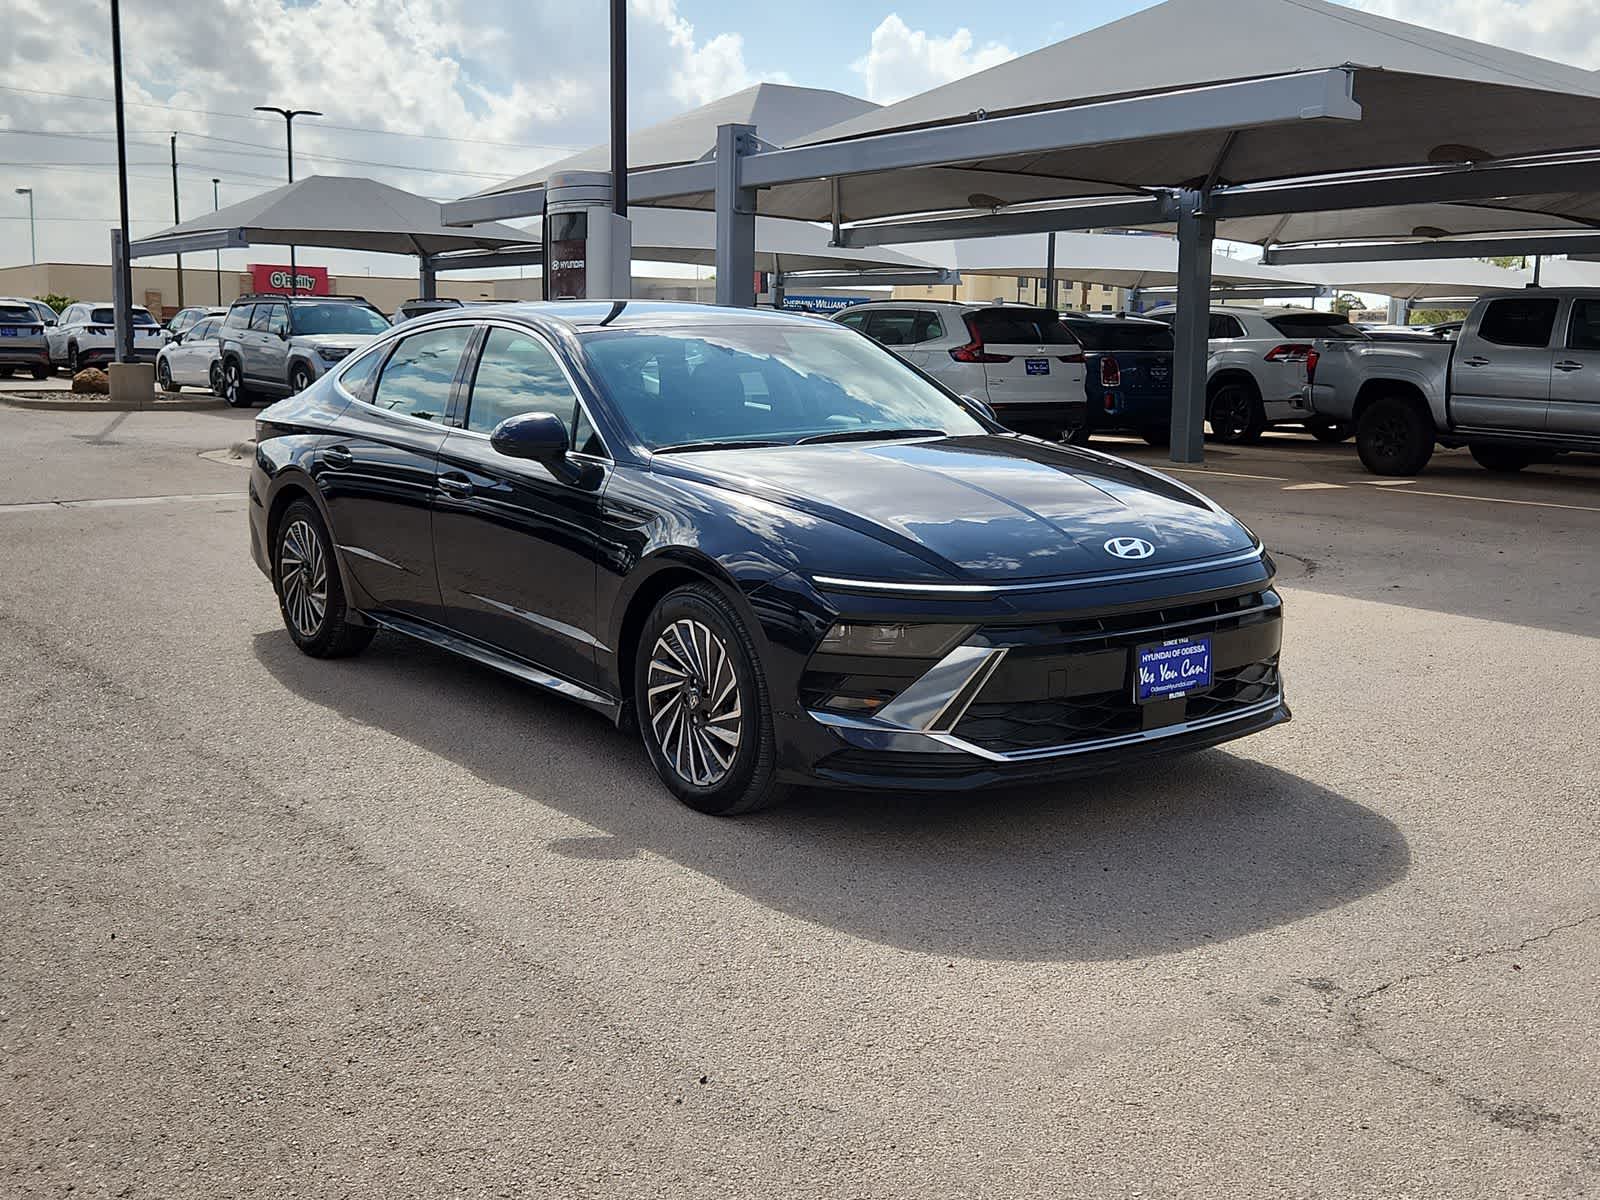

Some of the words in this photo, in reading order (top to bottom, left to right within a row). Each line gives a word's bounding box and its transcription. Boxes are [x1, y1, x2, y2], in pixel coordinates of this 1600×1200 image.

[560, 260, 585, 269] HYUNDAI
[271, 271, 316, 290] O'Rilly
[1142, 650, 1172, 663] HYUNDAI
[1172, 648, 1181, 657] OF
[1181, 644, 1206, 656] ODESSA
[1139, 666, 1155, 685] Yes
[1159, 663, 1178, 682] You
[1181, 655, 1208, 677] Can!
